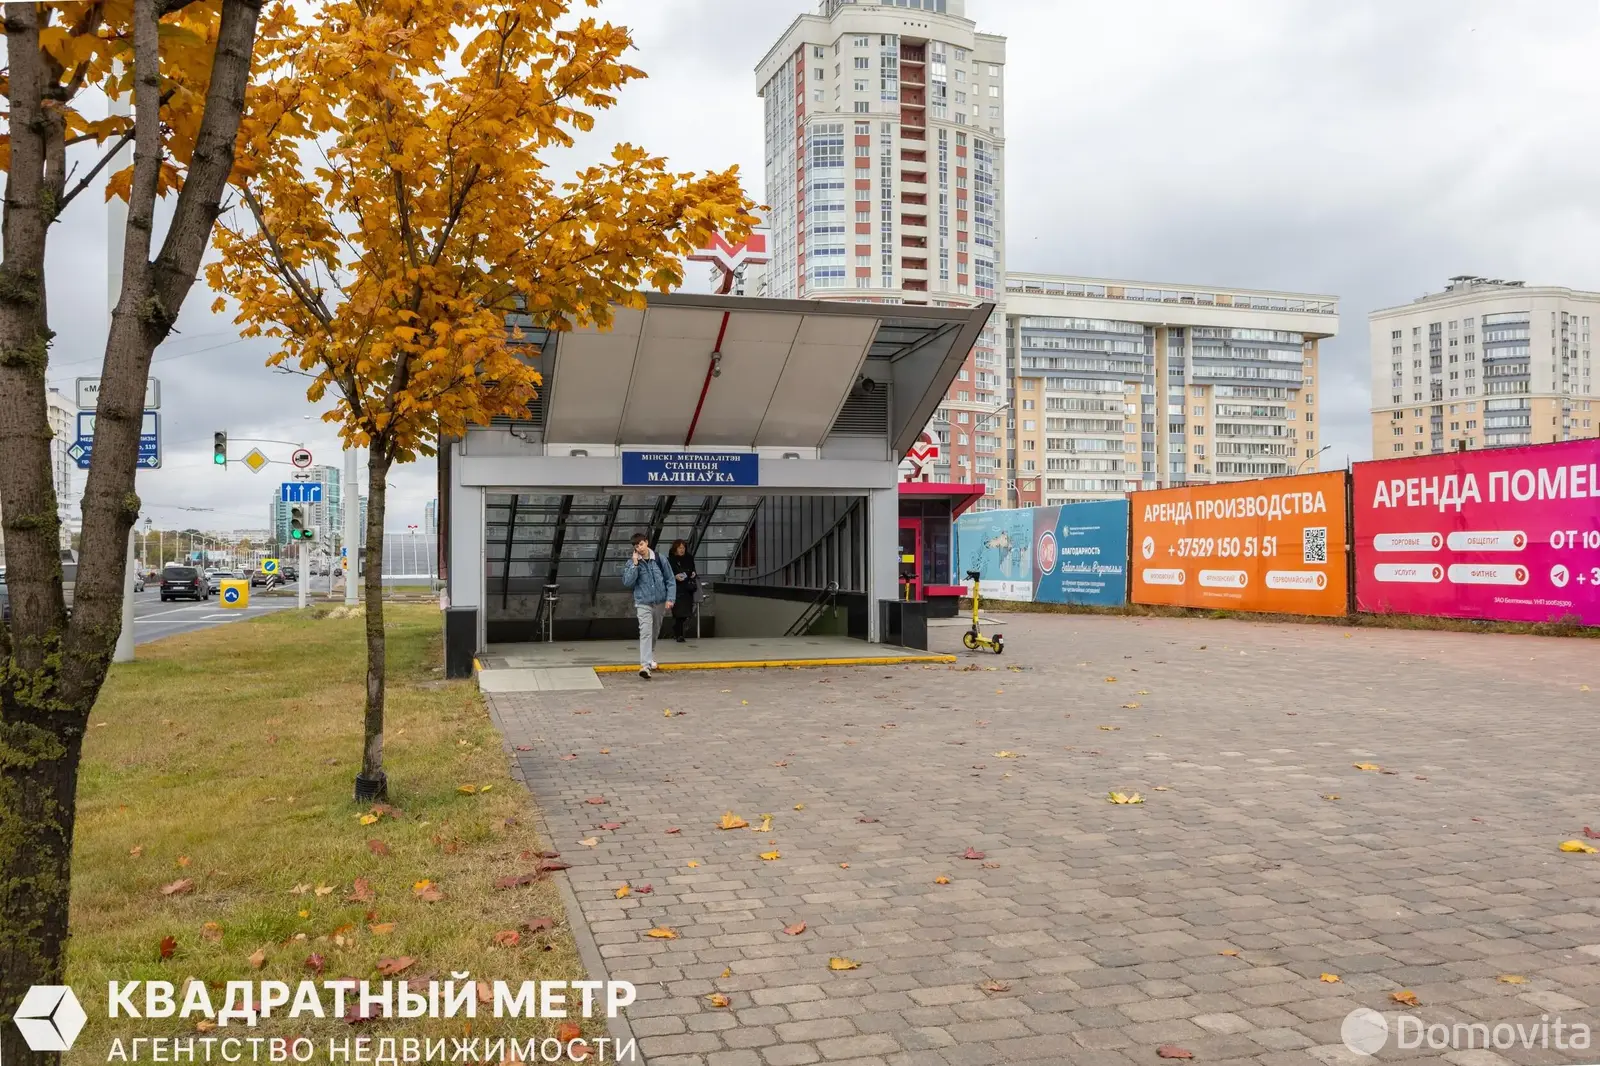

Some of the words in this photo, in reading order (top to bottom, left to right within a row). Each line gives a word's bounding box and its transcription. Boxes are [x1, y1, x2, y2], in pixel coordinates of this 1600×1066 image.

[677, 454, 741, 462] МЕТРАПАЛІТЭН
[665, 462, 718, 470] СТАНЦЫЯ
[648, 471, 735, 482] МАЛІНАЎКА
[1372, 472, 1482, 513] АРЕНДА
[1143, 501, 1193, 525] АРЕНДА
[1195, 491, 1327, 521] ПРОИЗВОДСТВА
[1391, 538, 1420, 546] ТОРГОВЫЕ
[1467, 537, 1499, 546] ОБЩЕПИТ
[1549, 530, 1578, 549] ОТ
[1217, 537, 1240, 557] 150
[1243, 536, 1258, 557] 51
[1261, 535, 1277, 557] 51
[1061, 547, 1101, 556] БЛАГОДАРНОСТЬ
[1470, 570, 1497, 578] ФИТНЕС
[1272, 575, 1314, 584] ПЕРВОМАЙСКИЙ
